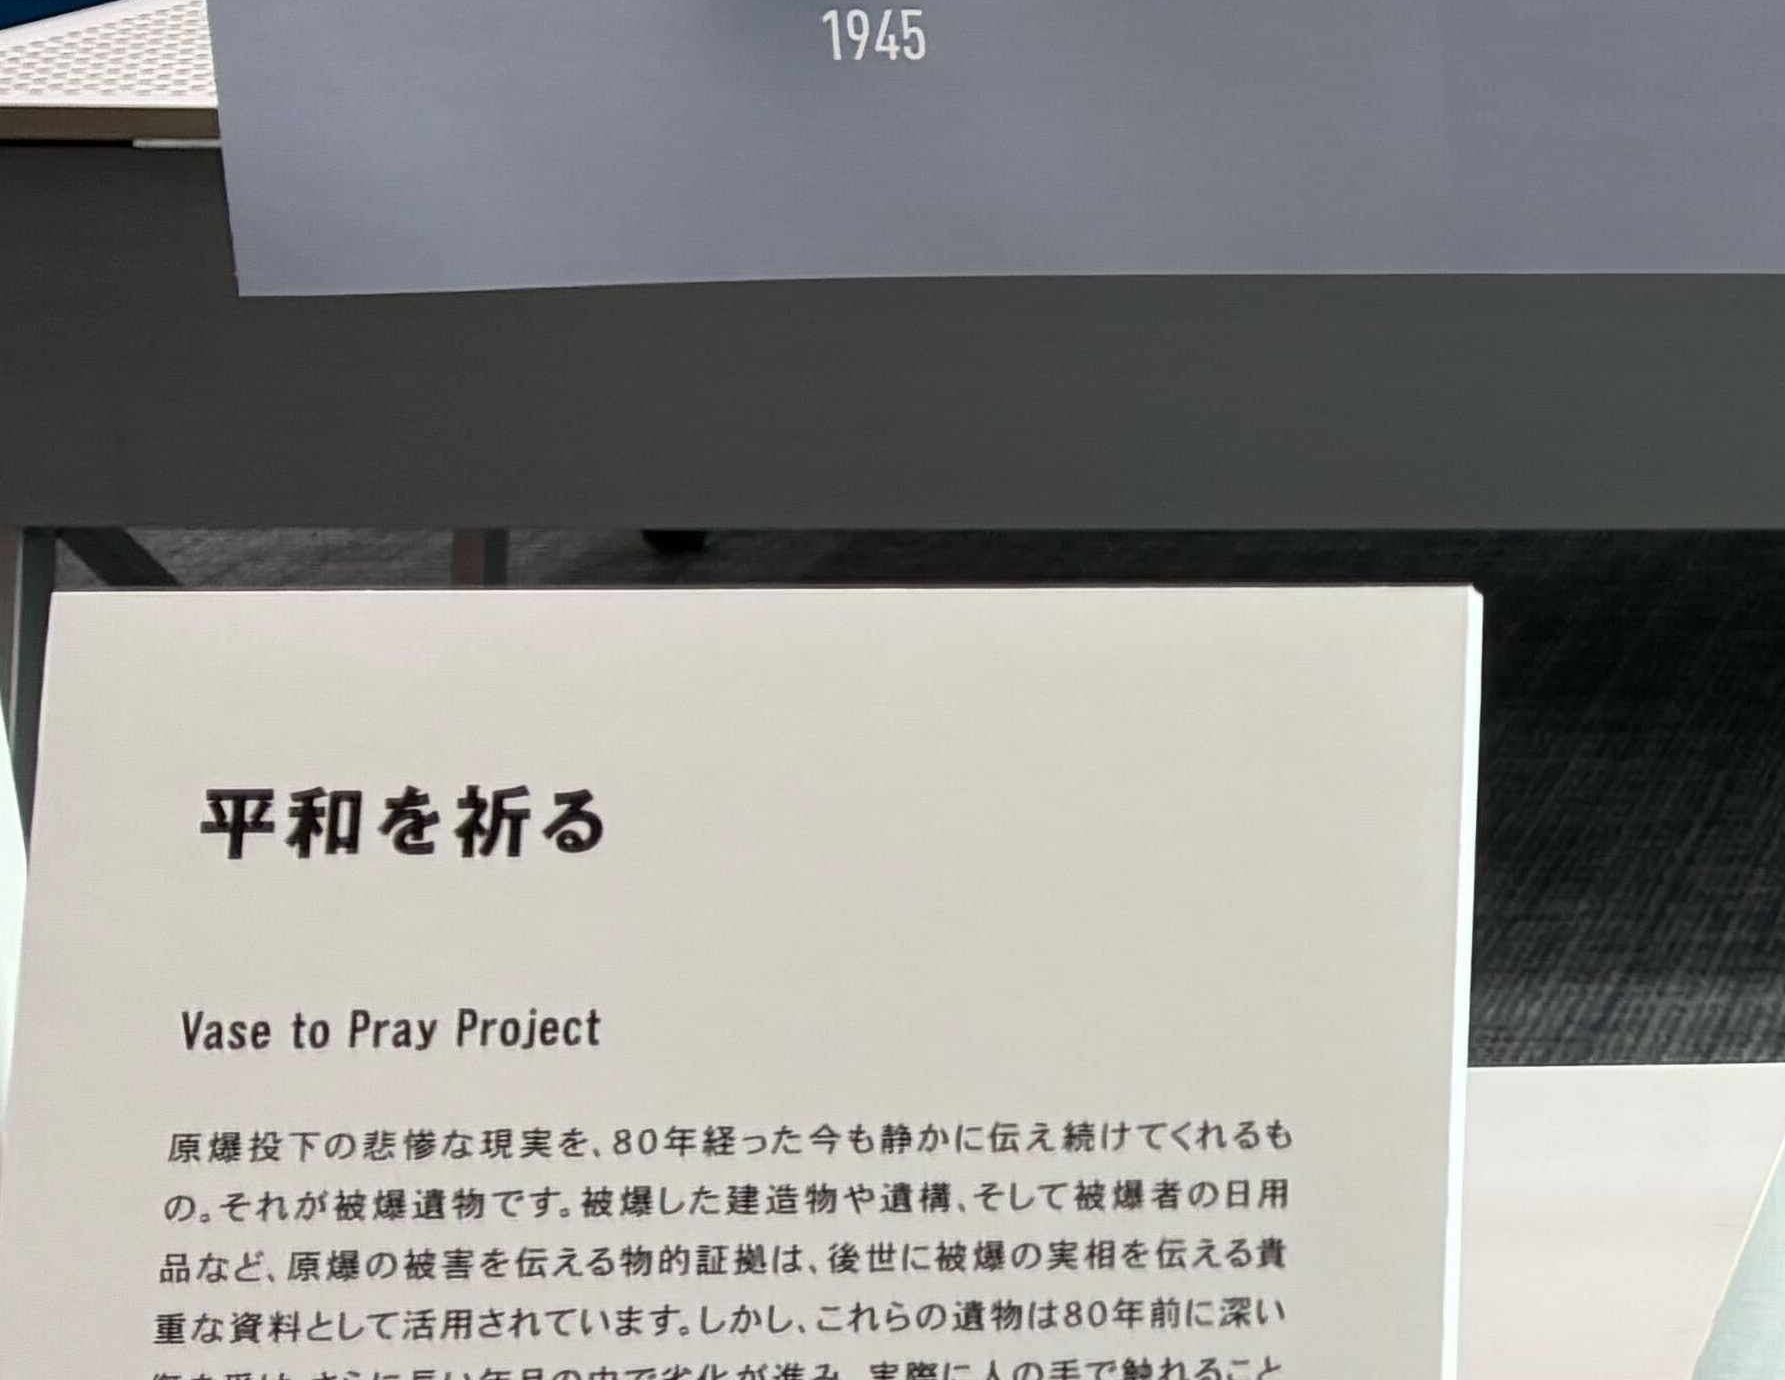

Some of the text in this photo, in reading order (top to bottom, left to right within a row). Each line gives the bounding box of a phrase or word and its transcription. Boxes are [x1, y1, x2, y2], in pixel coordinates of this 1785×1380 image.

[821, 8, 927, 61] 1945
[200, 784, 604, 860] 平和を祈る
[181, 1007, 601, 1052] Vase to Pray Project
[168, 1119, 1292, 1164] 原爆投下の悲惨な現実を、80年経った今も静かに伝え続けてくれるも
[164, 1178, 1289, 1224] の。それが被爆遺物です。被爆した建造物や遺構、そして被爆者の日用
[160, 1236, 1287, 1284] 品など、原爆の被害を伝える物的証拠は、後世に被爆の実相を伝える貴
[154, 1297, 1285, 1346] 重な資料として活用されています。しかし、これらの遺物は80年前に深い
